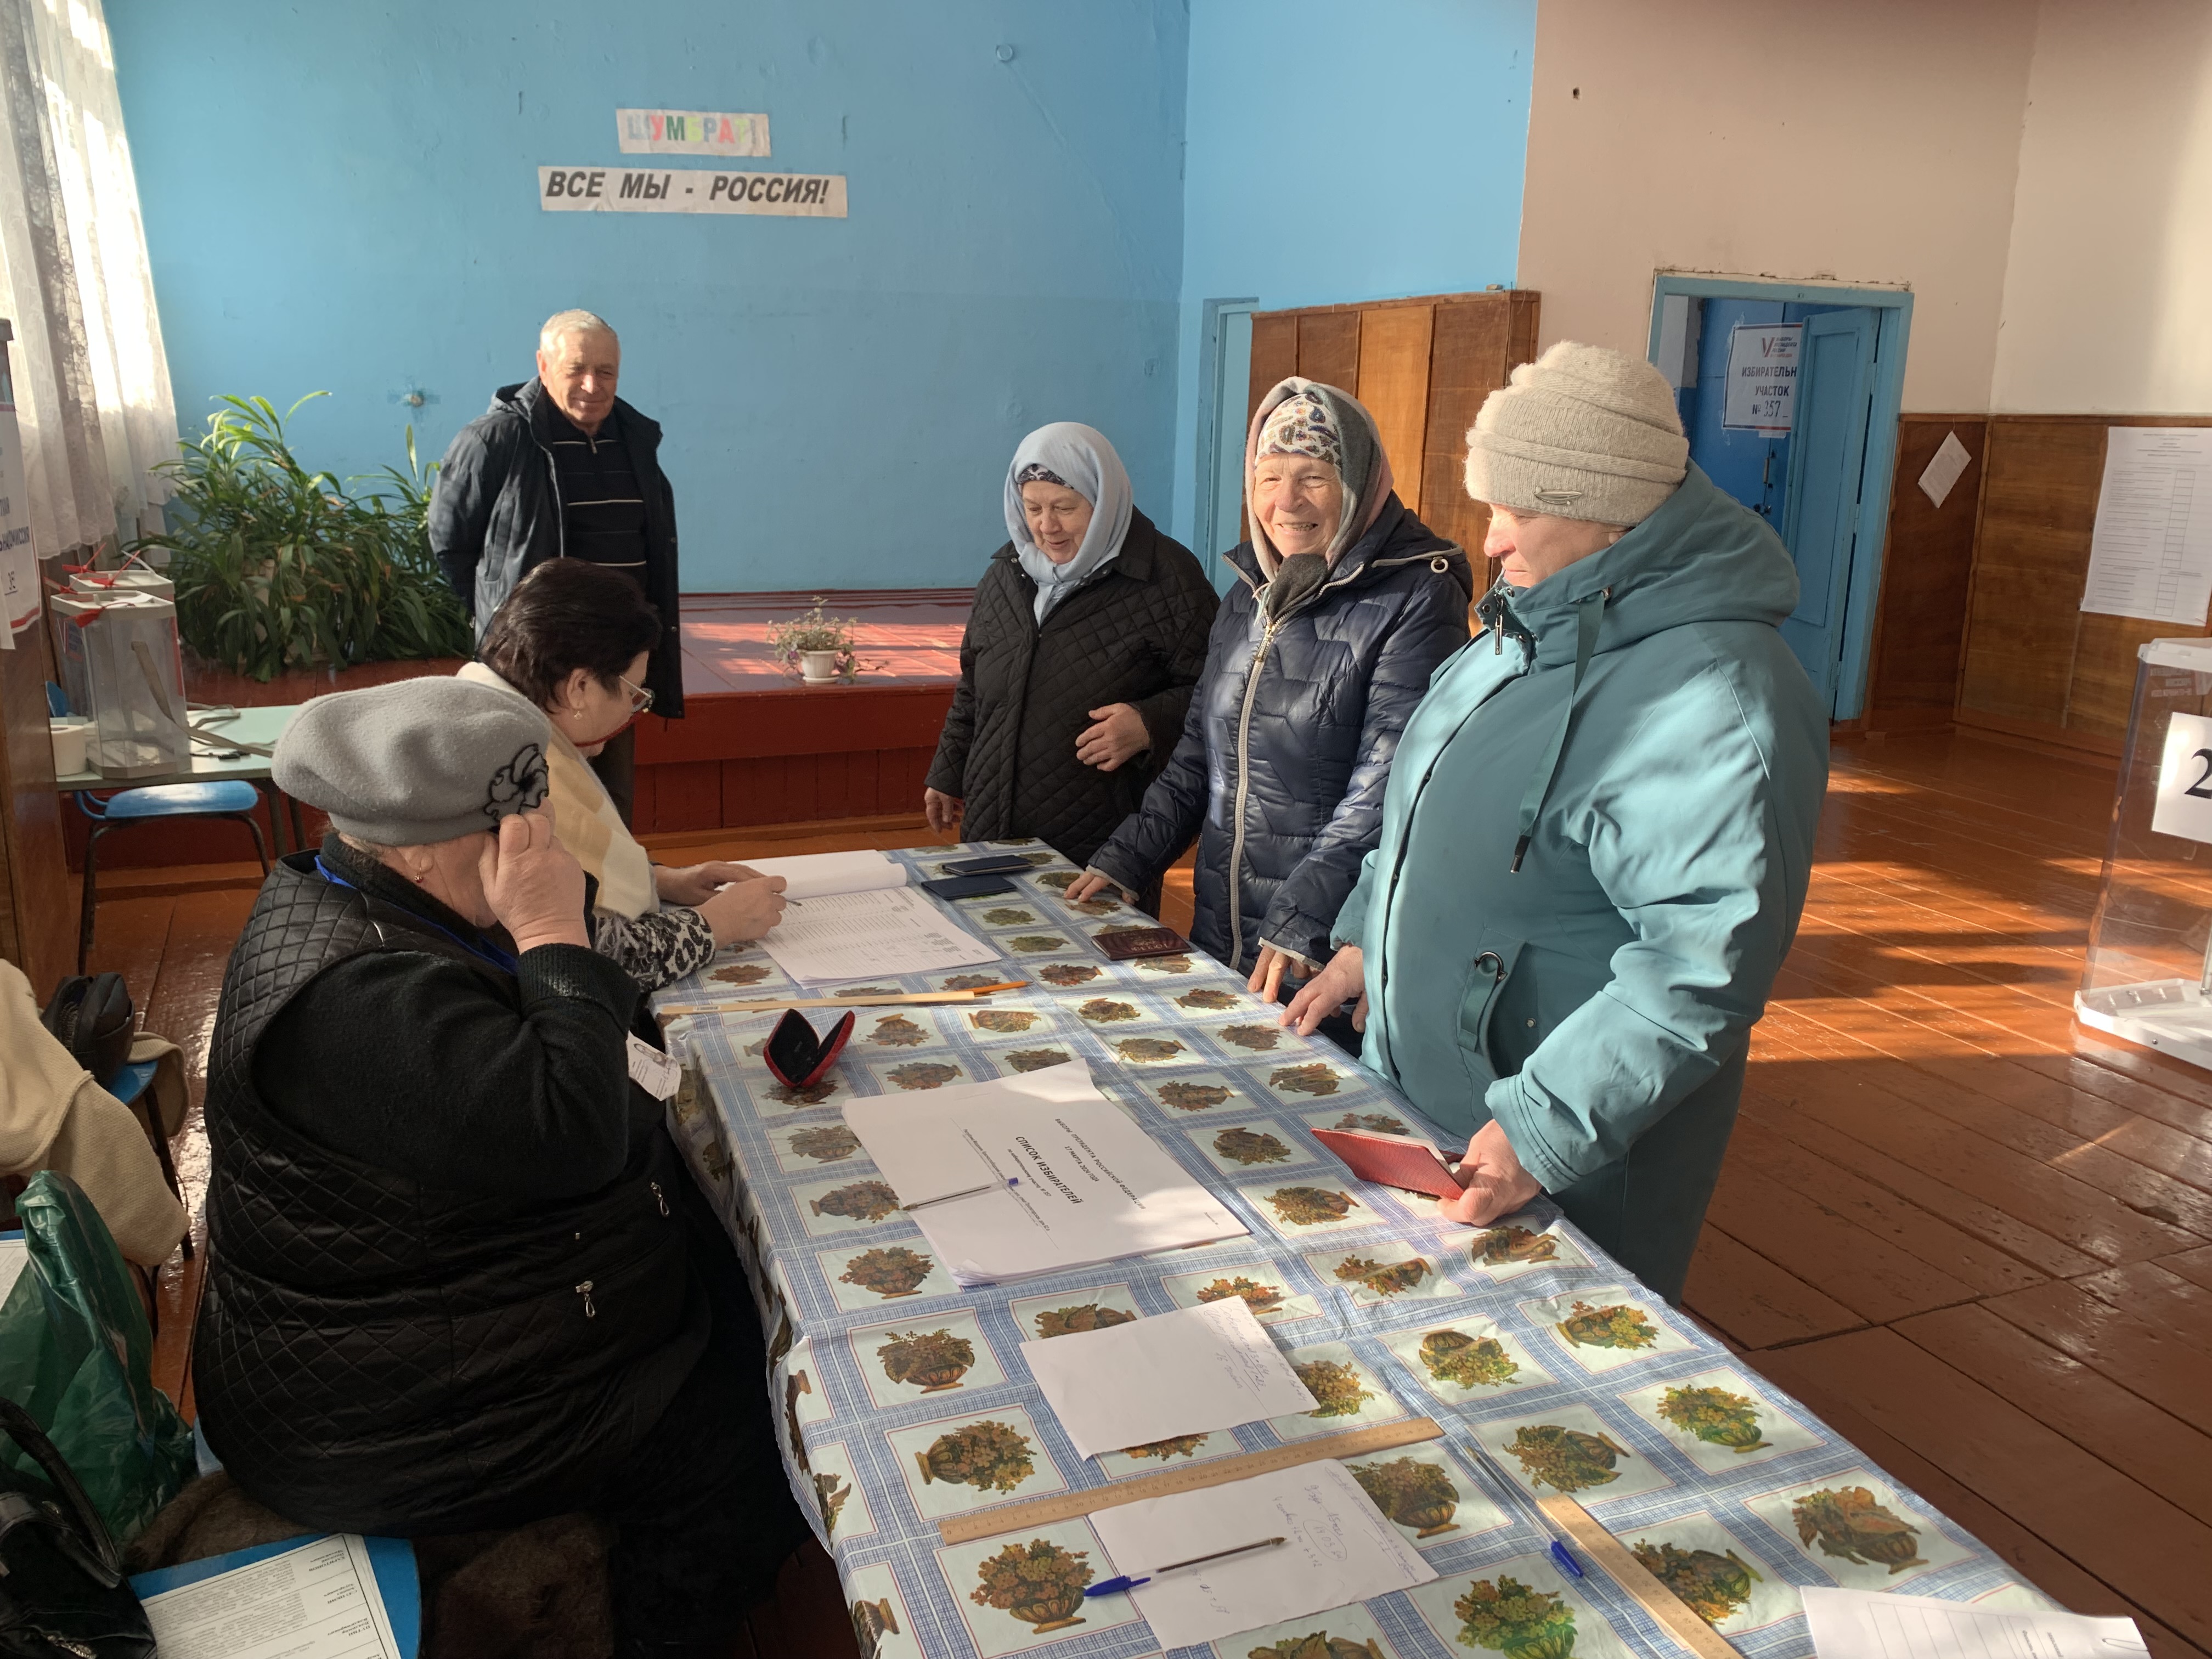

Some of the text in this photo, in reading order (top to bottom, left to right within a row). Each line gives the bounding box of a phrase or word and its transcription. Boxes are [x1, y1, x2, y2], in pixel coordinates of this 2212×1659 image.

[545, 171, 606, 198] ВСЕ
[619, 172, 672, 200] МЫ
[709, 175, 830, 204] РОССИЯ!
[1742, 366, 1797, 377] ИЗБИРАТЕЛЬН
[1755, 386, 1790, 397] УЧАСТОК
[1764, 400, 1781, 417] 357
[2185, 748, 2212, 800] 2
[1015, 1136, 1042, 1161] СПИСОК
[1036, 1161, 1084, 1204] ИЗБИРАТЕЛЕЙ
[1055, 1118, 1146, 1210] ВЫБОРЫ ПРЕЗИДЕНТА РОССИЙСКОЙ ФЕДЕРАЦИИ
[1069, 1149, 1083, 1165] МАРТА
[1079, 1164, 1091, 1174] 2024
[1087, 1173, 1099, 1182] ГОДА
